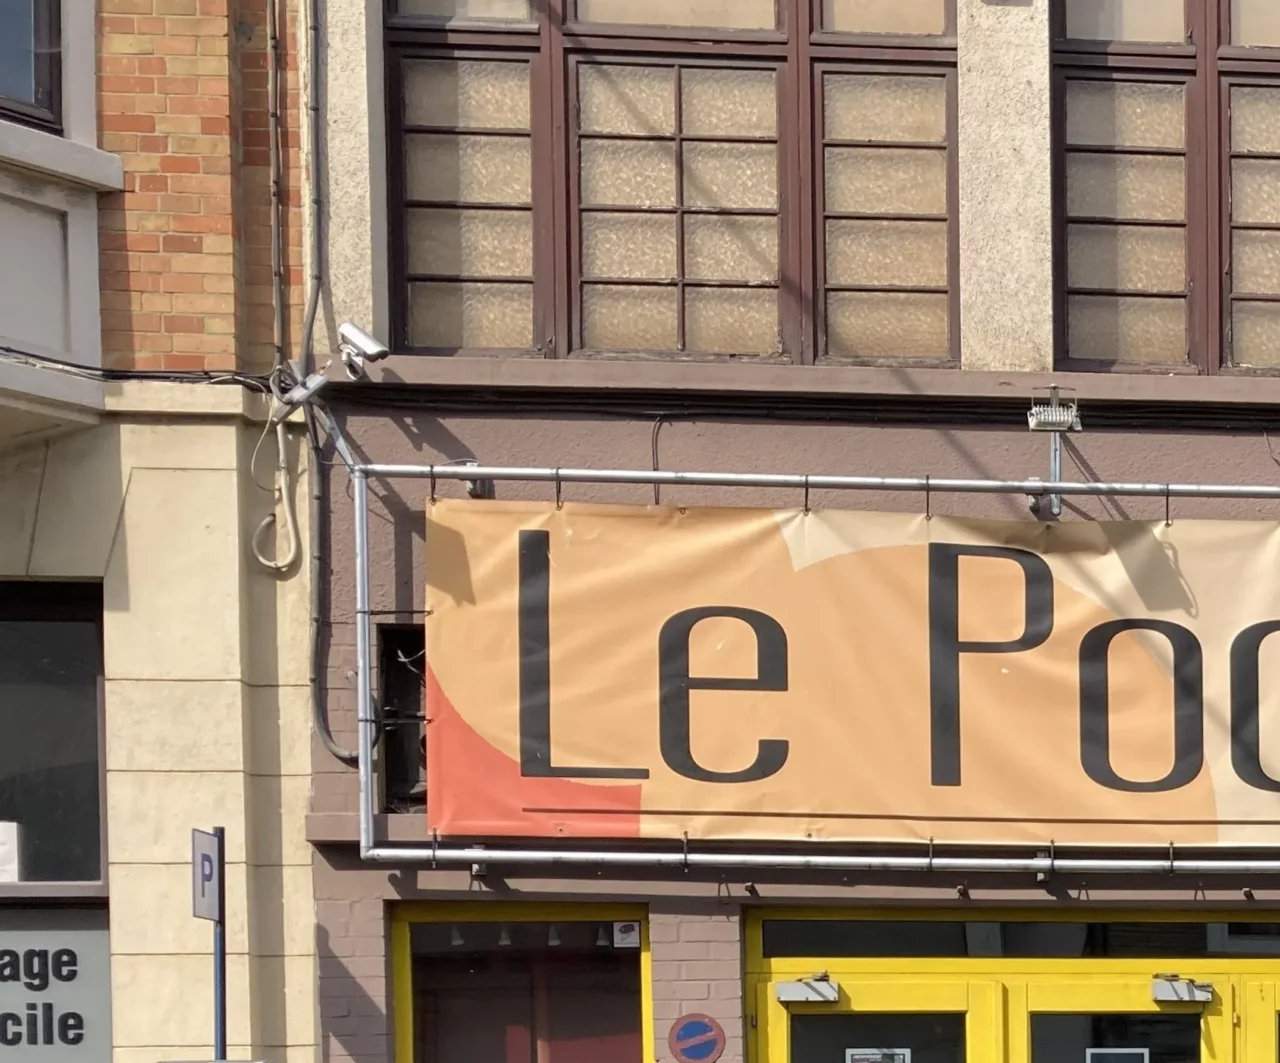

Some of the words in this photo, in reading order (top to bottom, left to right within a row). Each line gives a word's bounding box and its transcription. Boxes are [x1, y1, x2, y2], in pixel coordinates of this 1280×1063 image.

[518, 530, 789, 783] Le
[201, 853, 213, 898] P
[0, 1002, 84, 1046] cile
